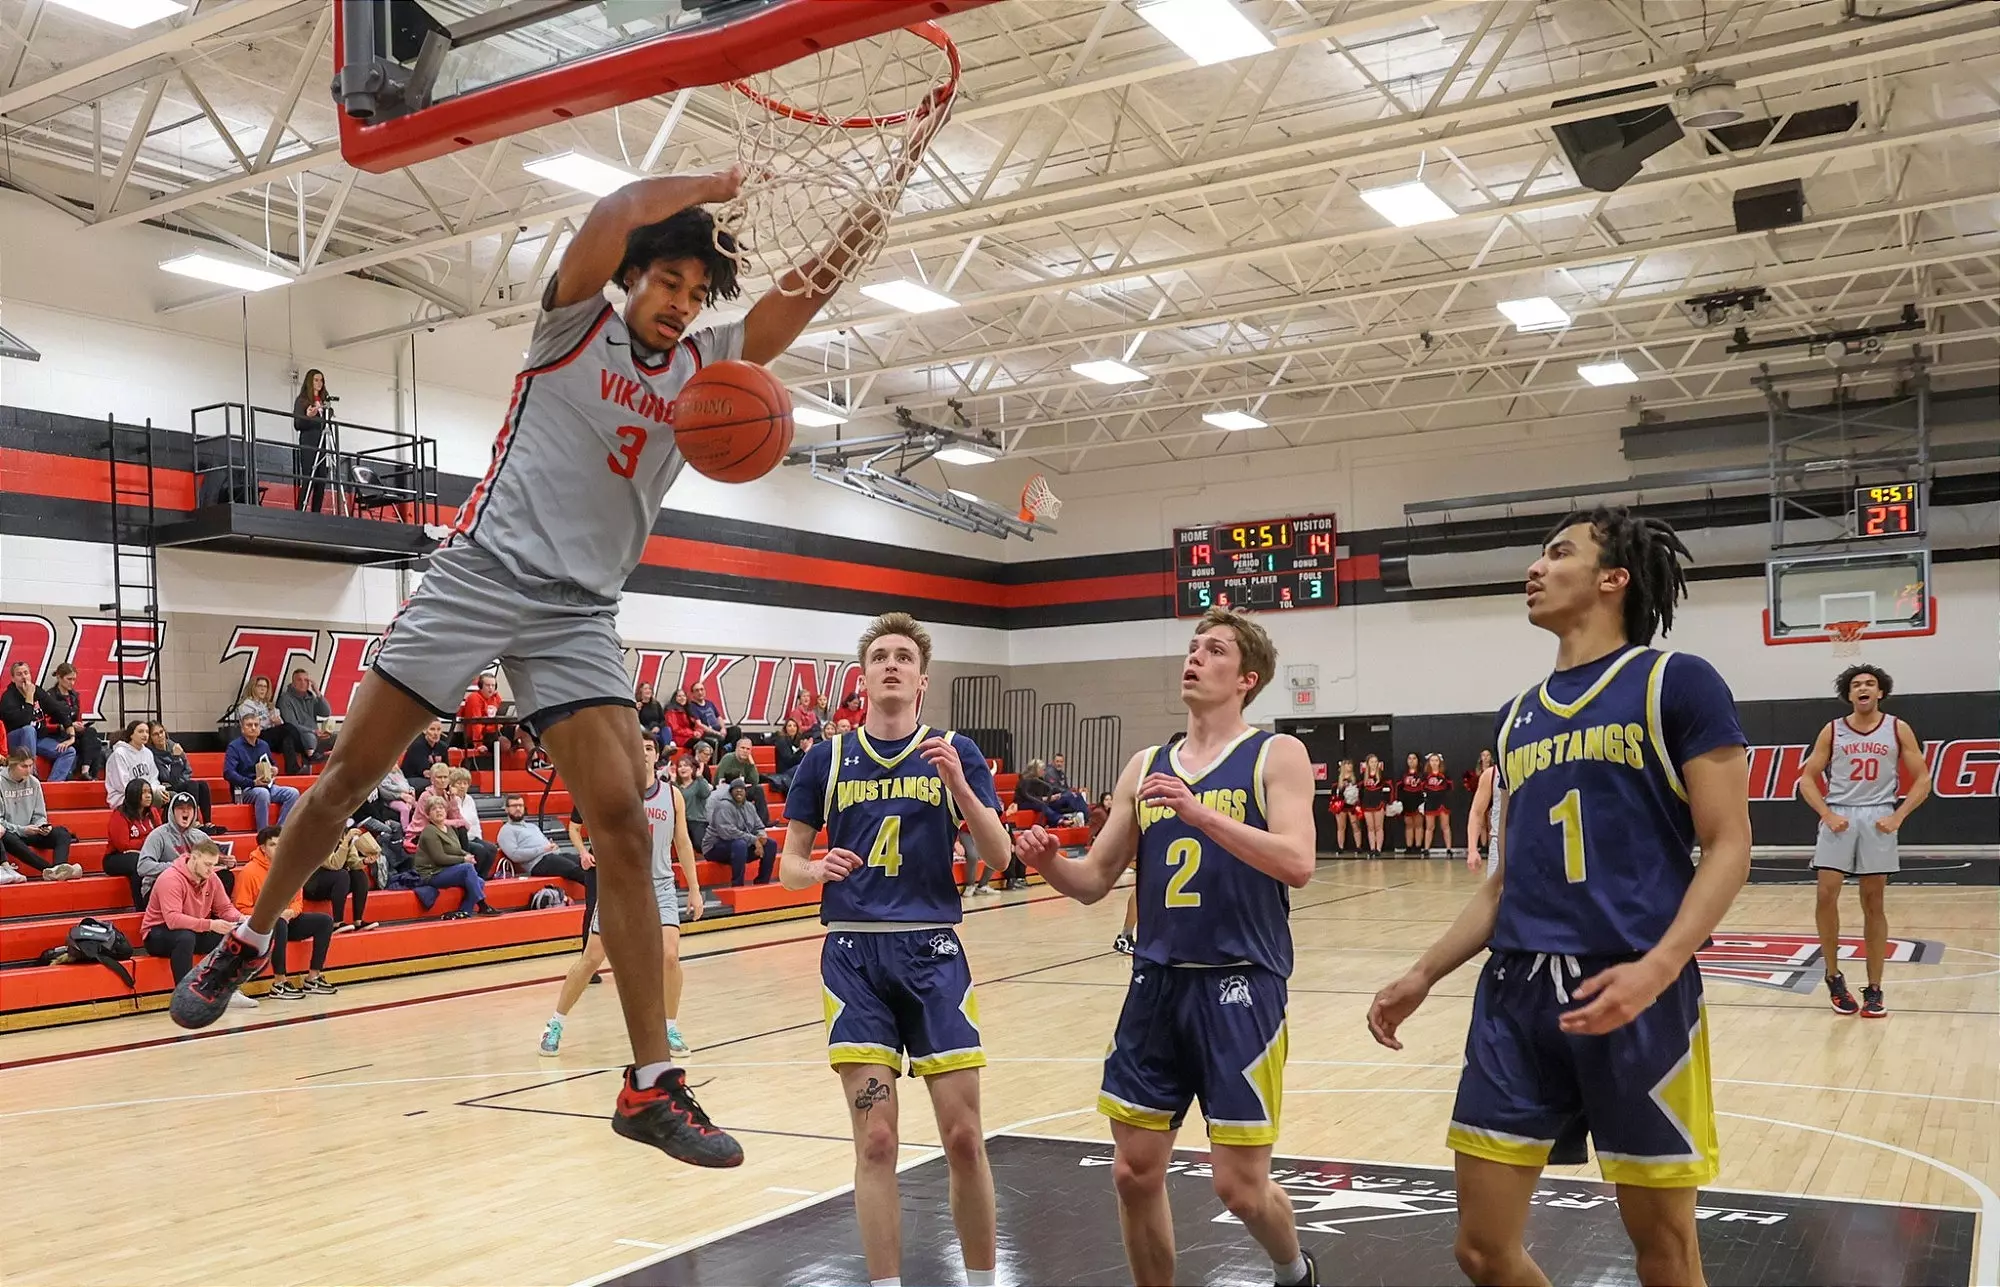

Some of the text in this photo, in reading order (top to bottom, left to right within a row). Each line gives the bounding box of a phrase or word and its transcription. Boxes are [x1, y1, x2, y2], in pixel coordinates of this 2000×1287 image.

[601, 368, 675, 425] VIKING
[607, 425, 647, 479] 3
[1870, 485, 1913, 503] 9:51
[1293, 518, 1332, 532] VISITOR
[1866, 505, 1908, 535] 27
[1180, 530, 1208, 542] HOME
[1232, 524, 1287, 548] 9:51
[1310, 533, 1330, 555] 14
[1192, 544, 1212, 566] 19
[1233, 558, 1259, 569] PERIOD
[1293, 558, 1318, 569] BONUS
[1191, 567, 1215, 577] BONUS
[1224, 575, 1277, 587] FOULS PLAYER
[1298, 571, 1322, 581] FOULS
[1188, 580, 1210, 589] FOULS
[1310, 580, 1322, 599] 3
[1199, 589, 1210, 607] 5
[1279, 600, 1294, 609] TOL
[1841, 741, 1889, 756] VIKINGS
[1506, 722, 1644, 796] MUSTANGS
[1850, 757, 1879, 781] 20
[837, 776, 942, 813] MUSTANGS
[1139, 788, 1247, 835] MUSNGS
[1549, 788, 1587, 883] 1
[867, 815, 903, 877] 4
[1165, 837, 1202, 909] 2
